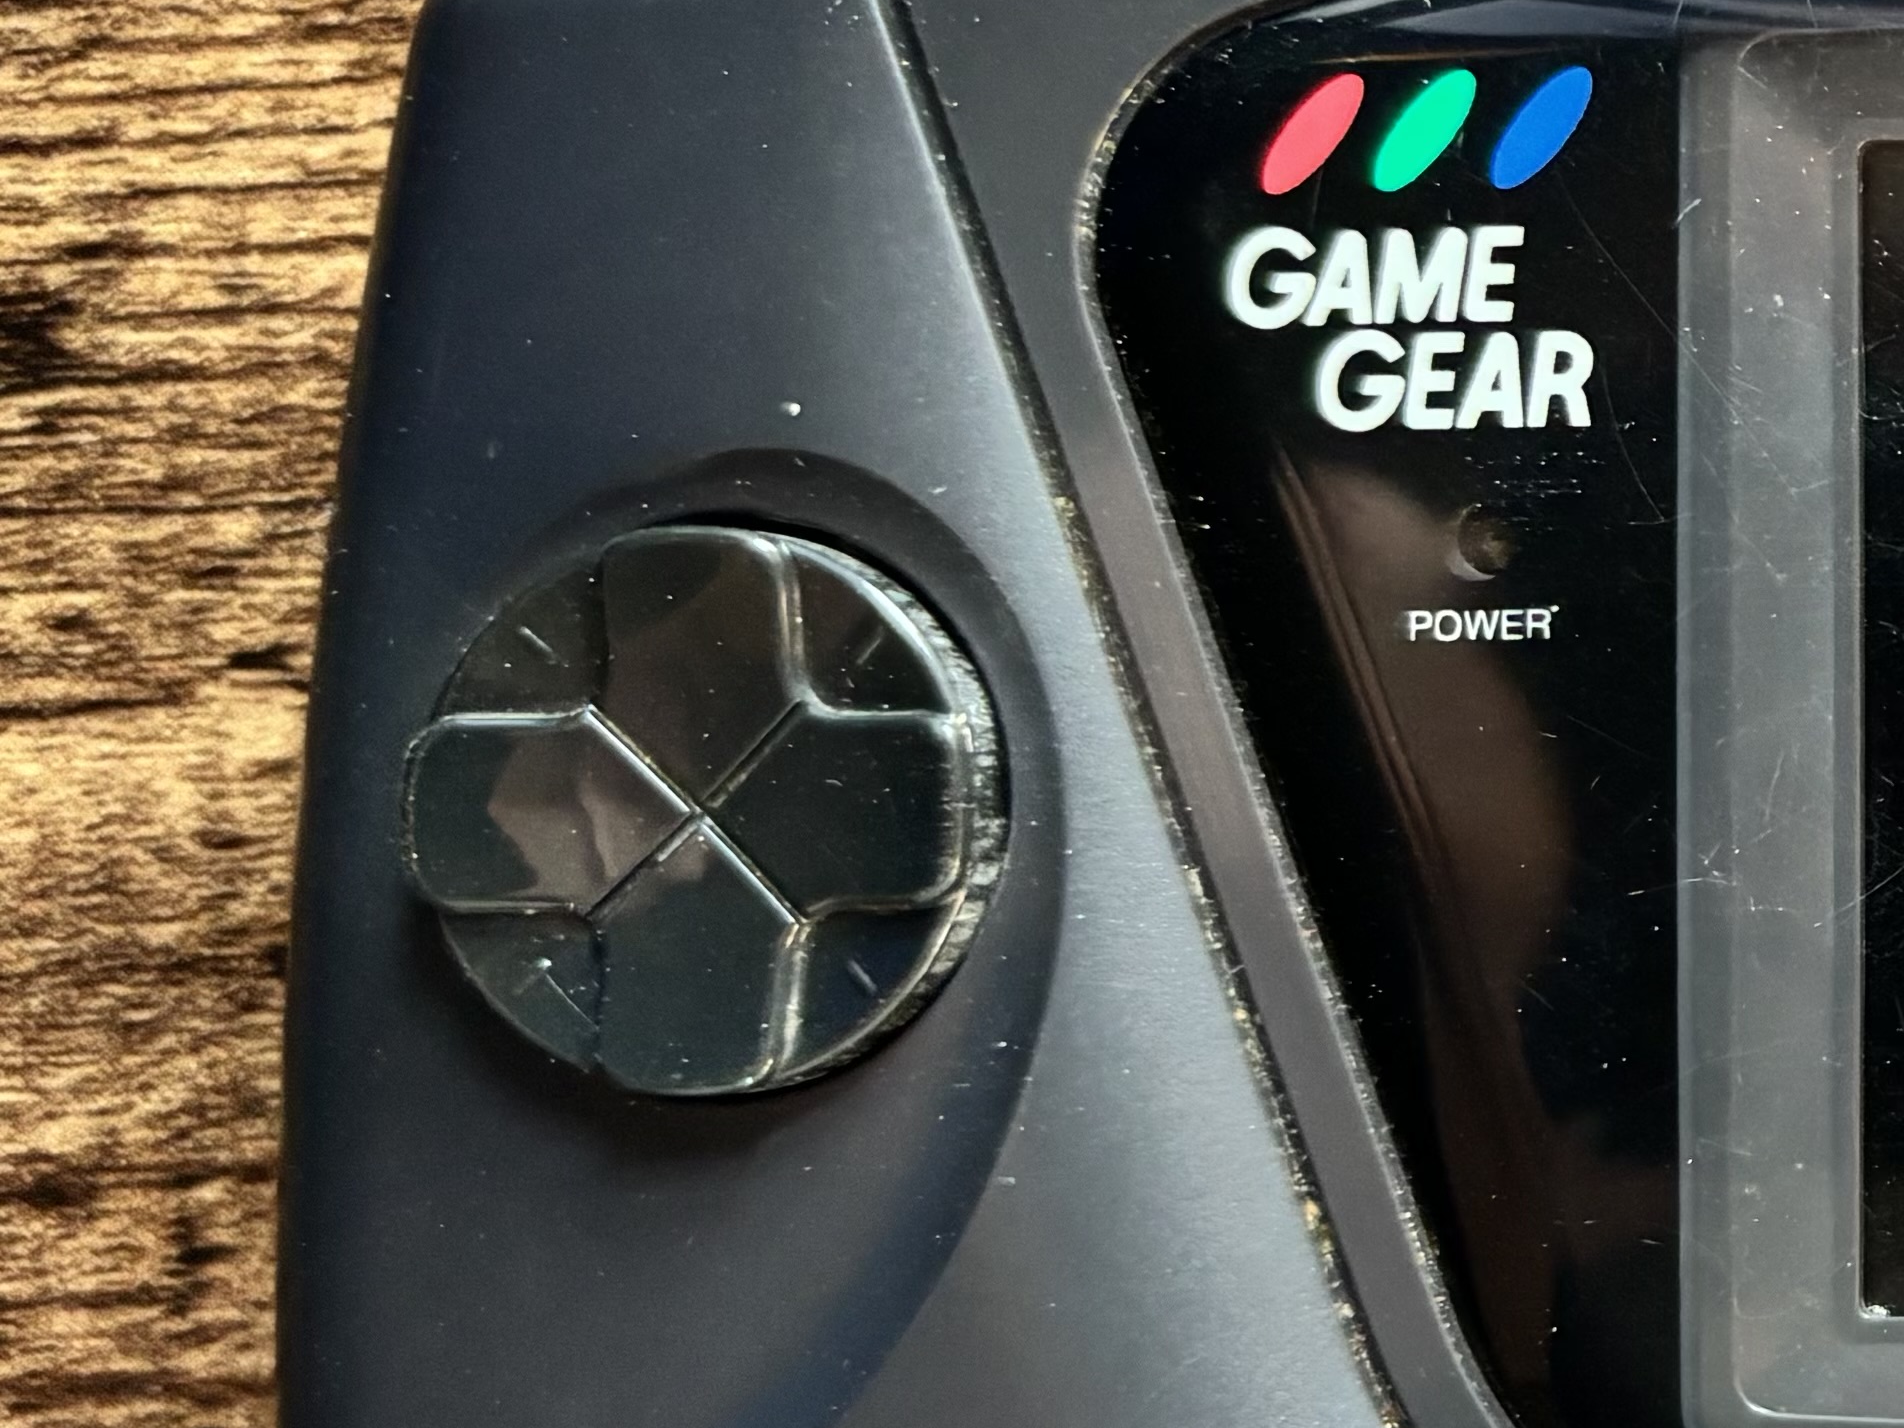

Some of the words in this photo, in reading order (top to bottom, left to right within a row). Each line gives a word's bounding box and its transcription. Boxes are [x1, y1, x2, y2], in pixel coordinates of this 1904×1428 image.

[1226, 225, 1525, 329] GAME
[1315, 329, 1594, 432] GEAR
[1408, 609, 1552, 641] POWER
